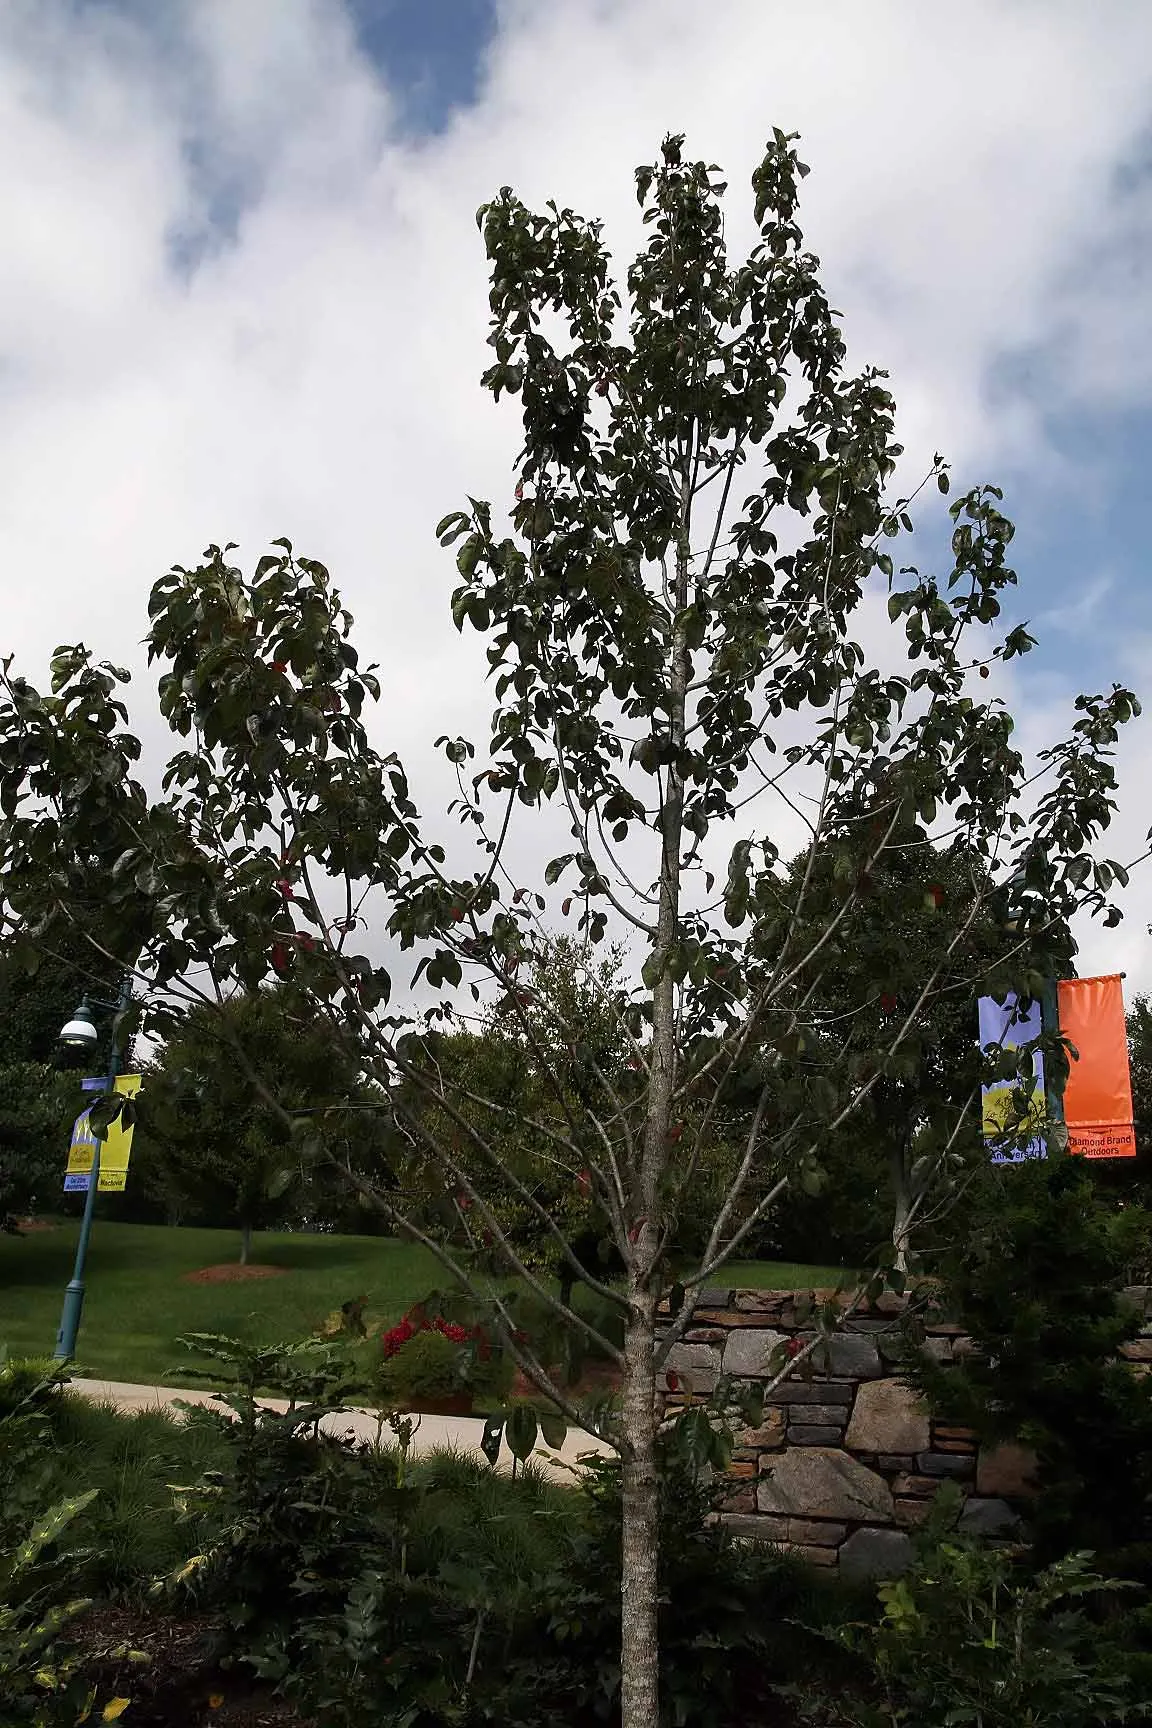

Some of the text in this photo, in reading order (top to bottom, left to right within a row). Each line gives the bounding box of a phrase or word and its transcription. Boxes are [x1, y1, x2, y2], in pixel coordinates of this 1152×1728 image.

[1069, 1135, 1131, 1146] Diamond Brand
[1081, 1147, 1119, 1156] Outdoors
